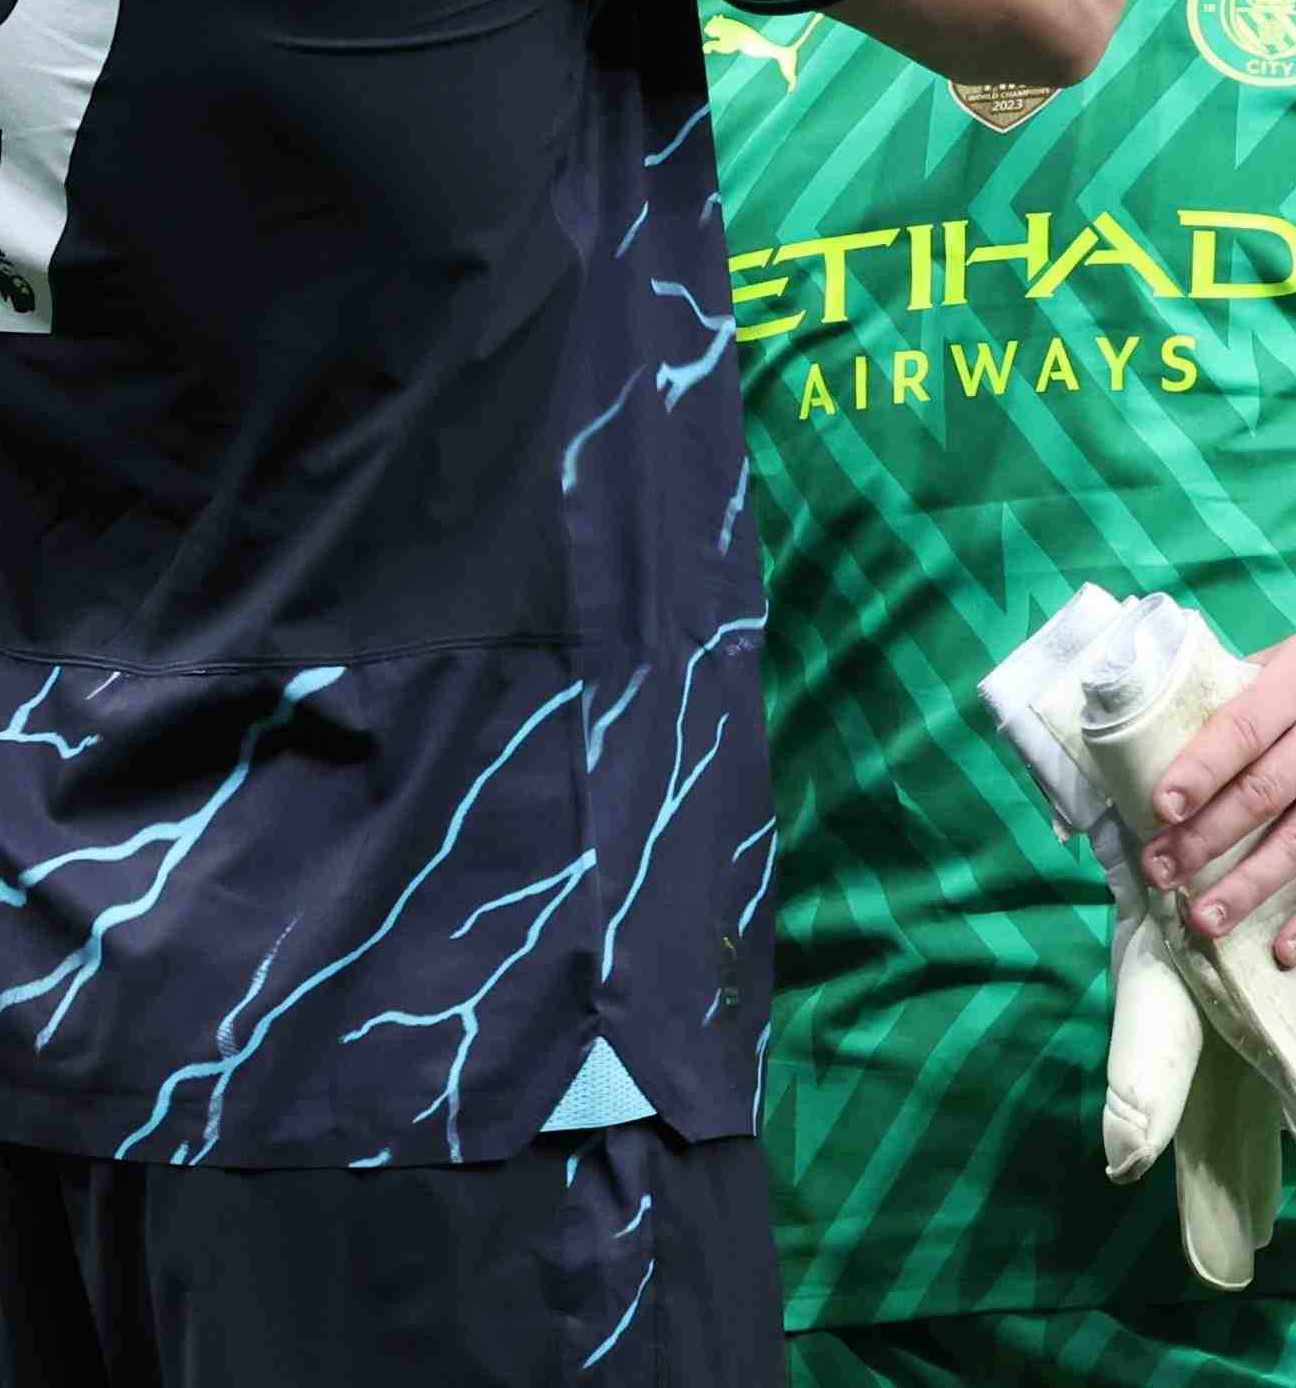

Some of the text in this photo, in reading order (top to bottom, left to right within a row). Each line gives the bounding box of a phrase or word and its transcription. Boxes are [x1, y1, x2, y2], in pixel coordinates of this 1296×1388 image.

[1246, 59, 1295, 77] CITY
[991, 98, 1024, 112] 2023
[799, 335, 1198, 420] AIRWAYS
